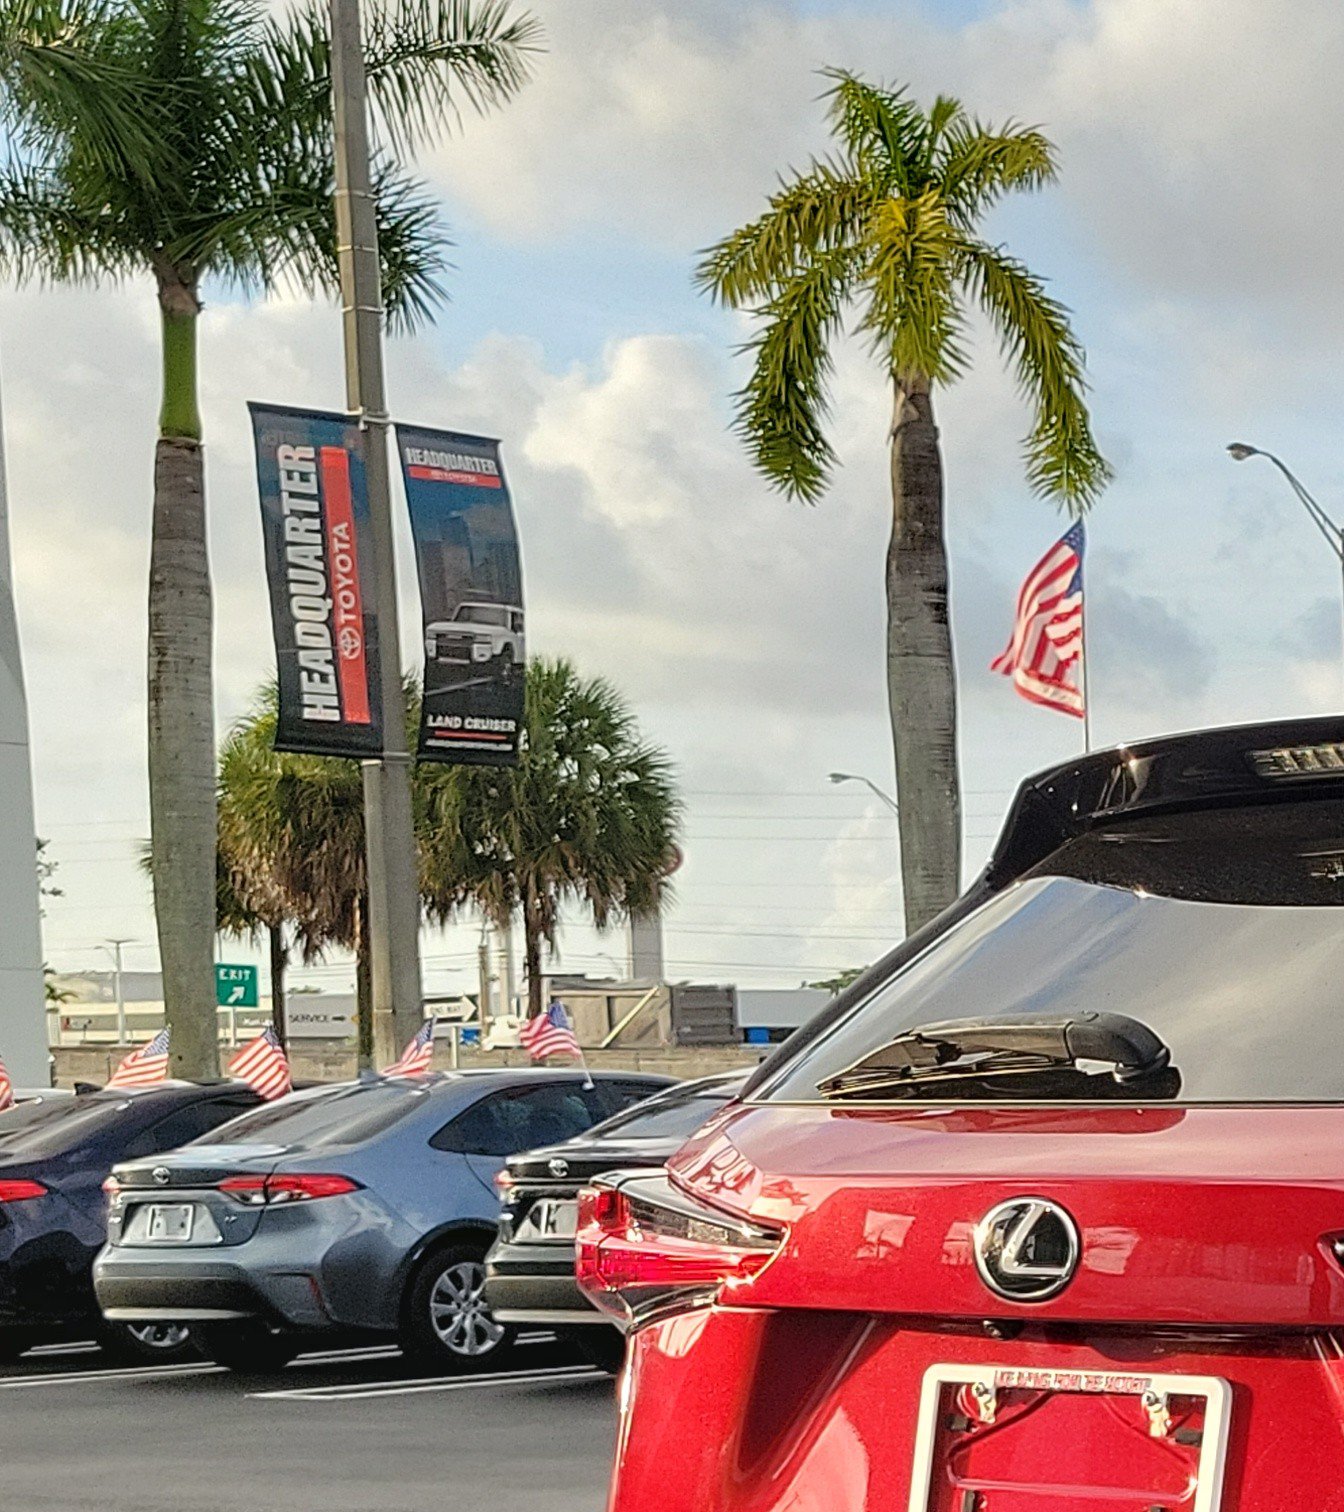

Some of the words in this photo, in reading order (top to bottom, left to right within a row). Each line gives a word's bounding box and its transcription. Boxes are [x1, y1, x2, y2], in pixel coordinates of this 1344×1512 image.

[405, 446, 499, 476] HEADQUARTER
[276, 443, 341, 723] HEADQUARTER
[332, 521, 360, 623] TOYOTA
[427, 713, 462, 729] LAND
[463, 716, 517, 732] CRUISER
[218, 967, 252, 981] EXIT
[287, 1013, 329, 1024] SERVICE
